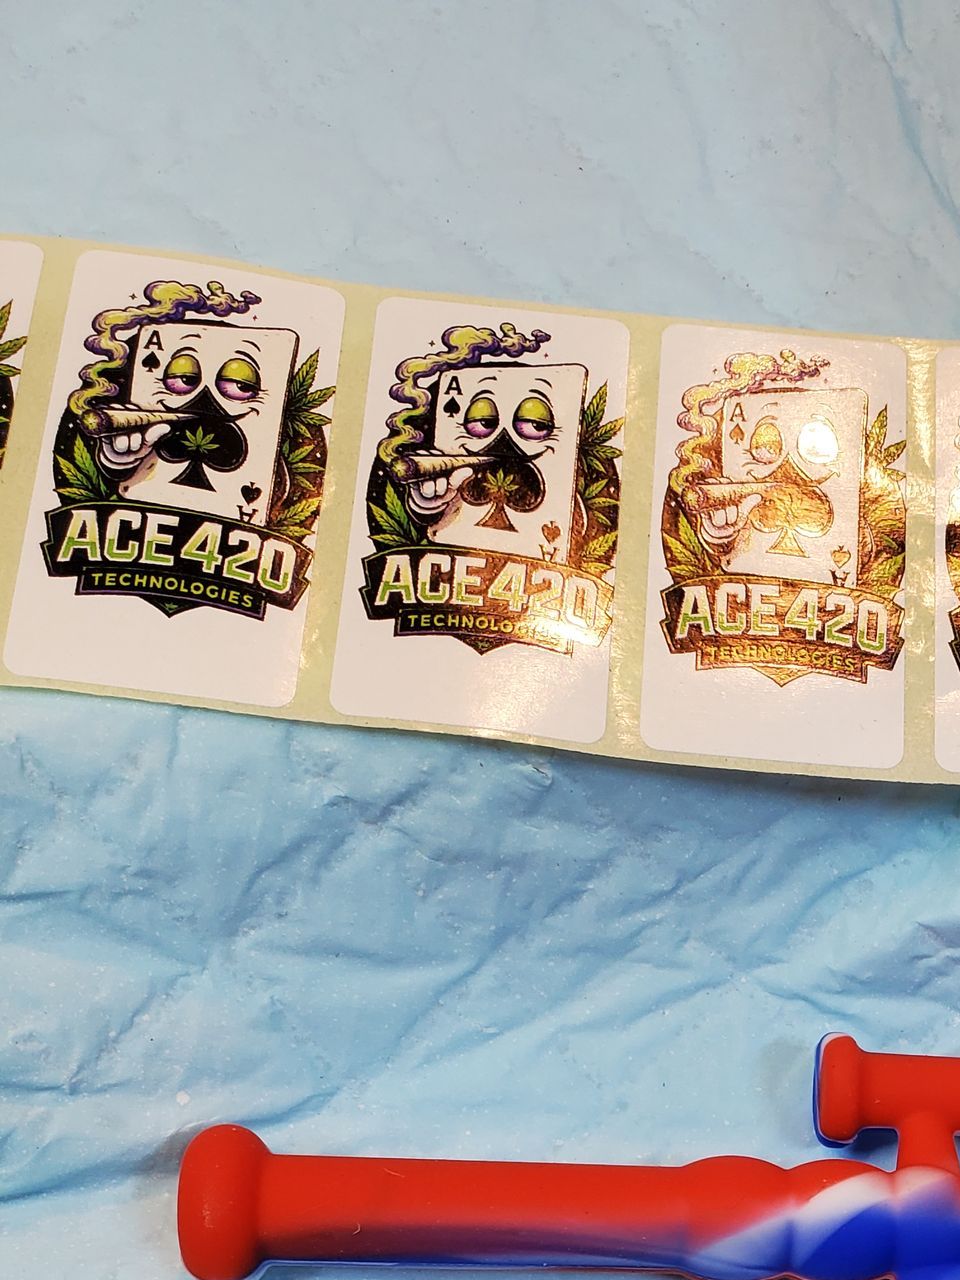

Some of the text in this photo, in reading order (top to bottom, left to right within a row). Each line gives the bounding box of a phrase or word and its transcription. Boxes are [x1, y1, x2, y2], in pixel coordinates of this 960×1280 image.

[144, 330, 164, 351] A
[444, 377, 462, 395] A
[729, 402, 746, 422] A
[59, 510, 298, 594] ACE 420
[91, 573, 254, 608] TECHNOLOGIES
[374, 553, 599, 628] ACE 420
[675, 583, 887, 655] ACE 420
[708, 647, 856, 671] TECHNOLOGIES
